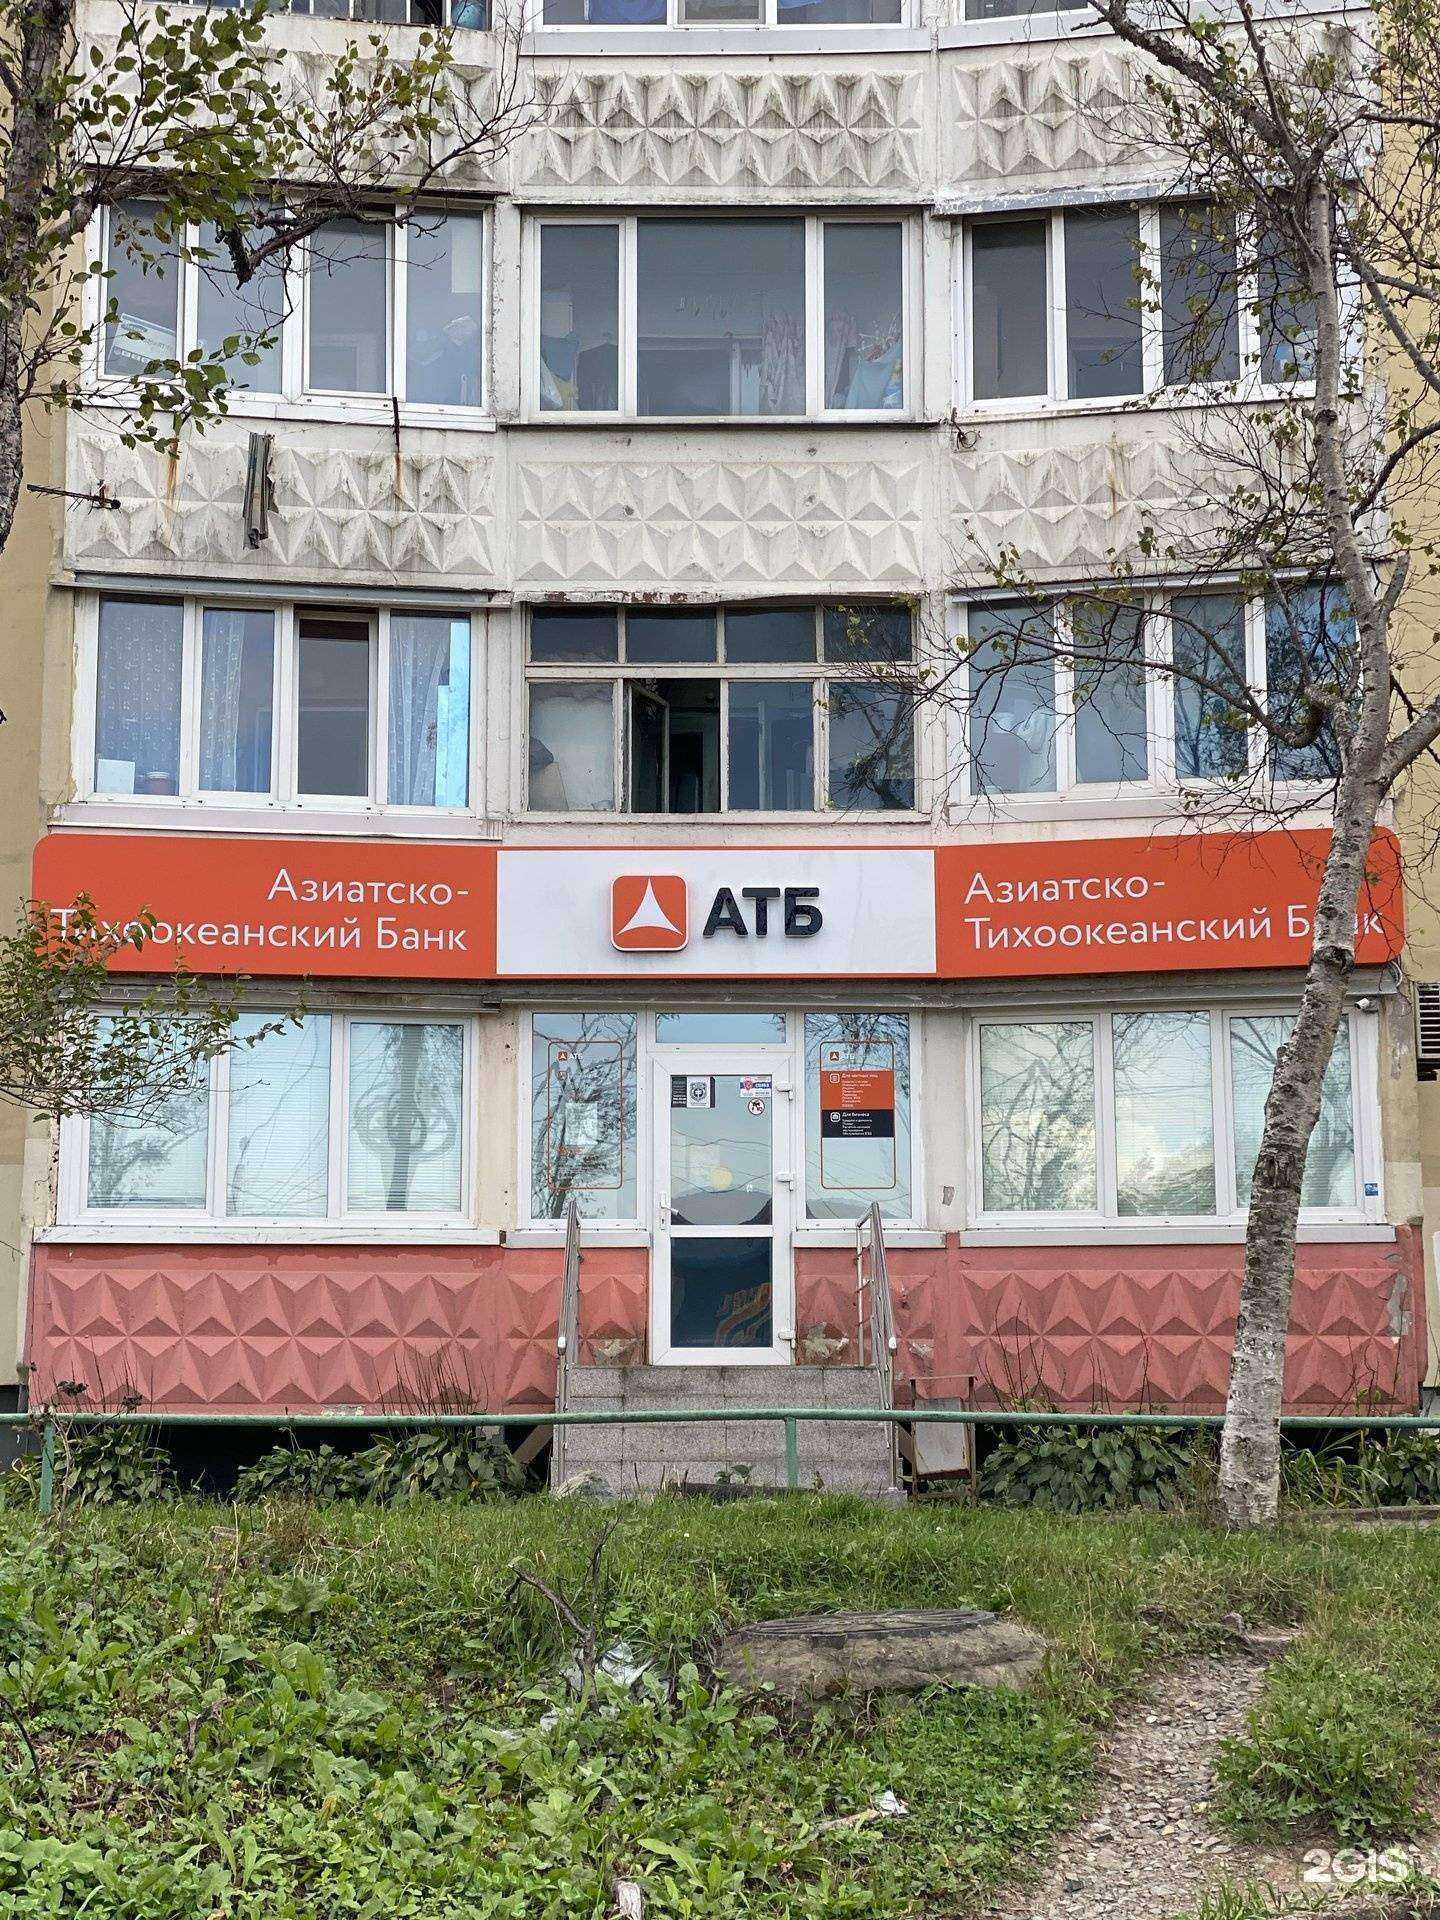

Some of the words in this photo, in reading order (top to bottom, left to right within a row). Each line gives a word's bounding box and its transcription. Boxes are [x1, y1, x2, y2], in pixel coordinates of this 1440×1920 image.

[267, 868, 469, 905] Азиатско-
[964, 872, 1166, 905] Азиатско-
[702, 887, 823, 938] АТБ
[964, 907, 1272, 949] Тихоокеанский
[1287, 903, 1384, 938] Бк
[376, 916, 468, 951] Банк
